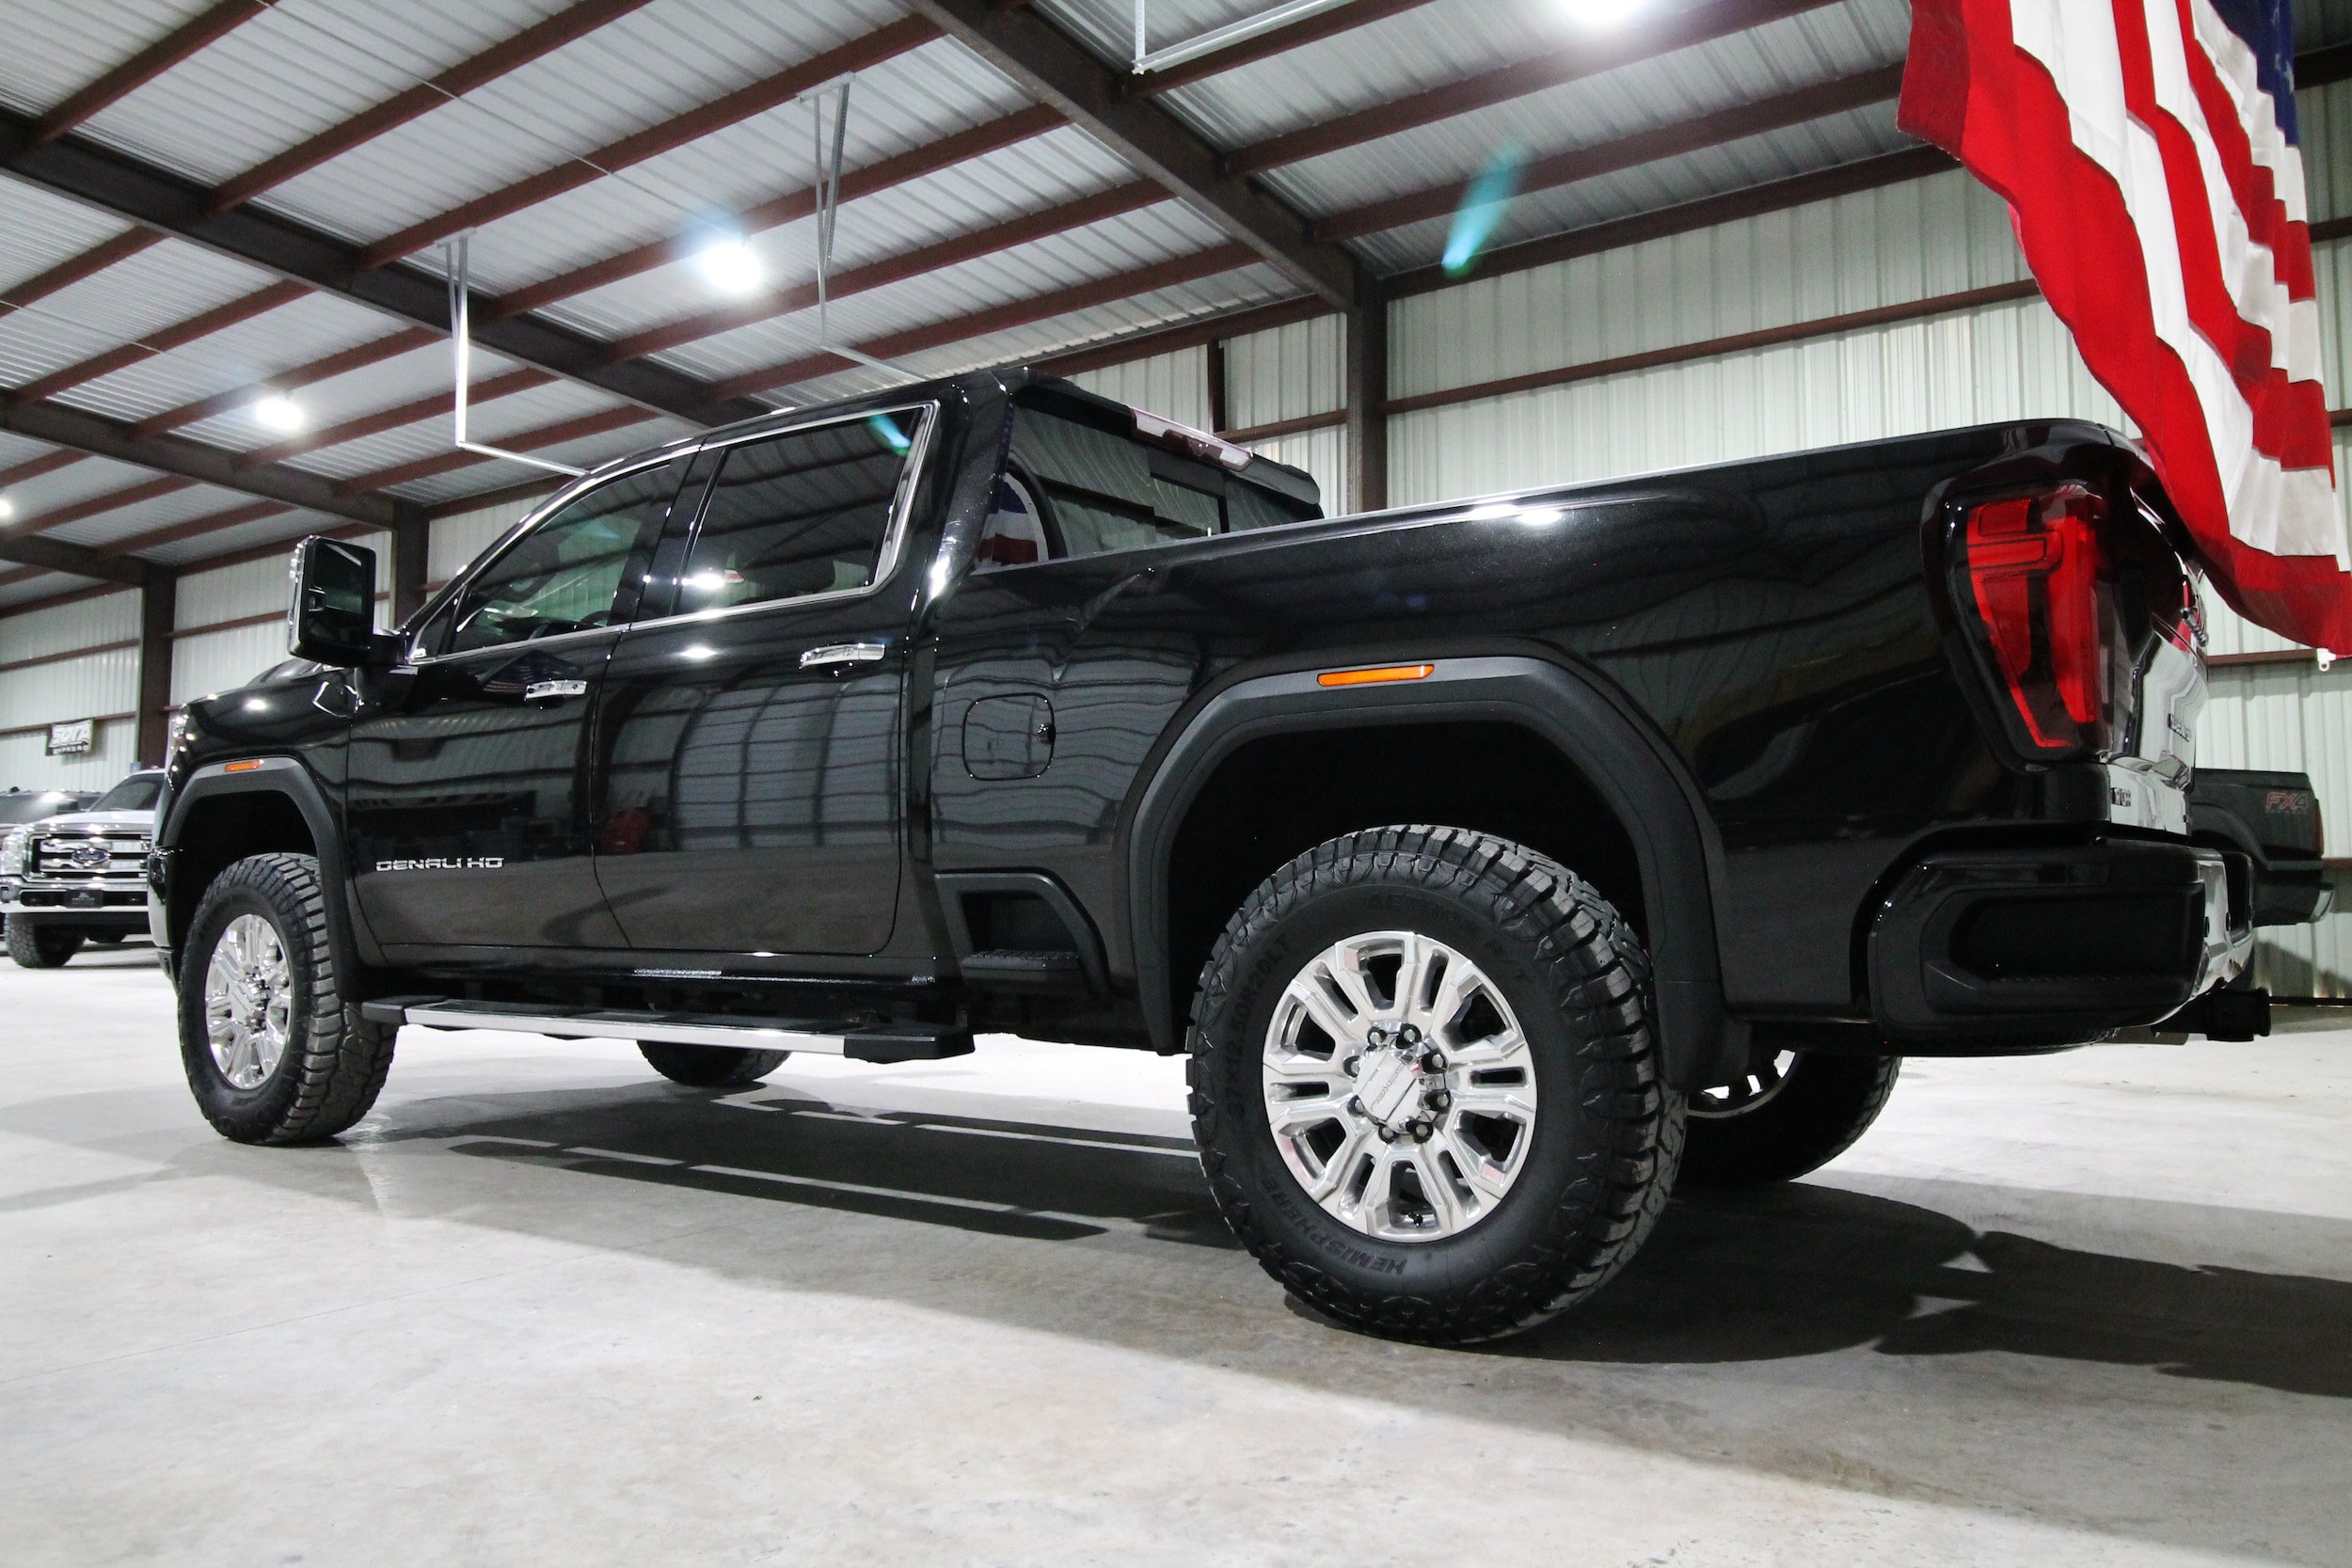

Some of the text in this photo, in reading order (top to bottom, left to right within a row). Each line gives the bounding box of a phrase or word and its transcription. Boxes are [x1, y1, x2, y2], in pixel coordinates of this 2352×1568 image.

[376, 857, 504, 872] DENALI HD
[1262, 1177, 1407, 1275] HEMISPHERE
